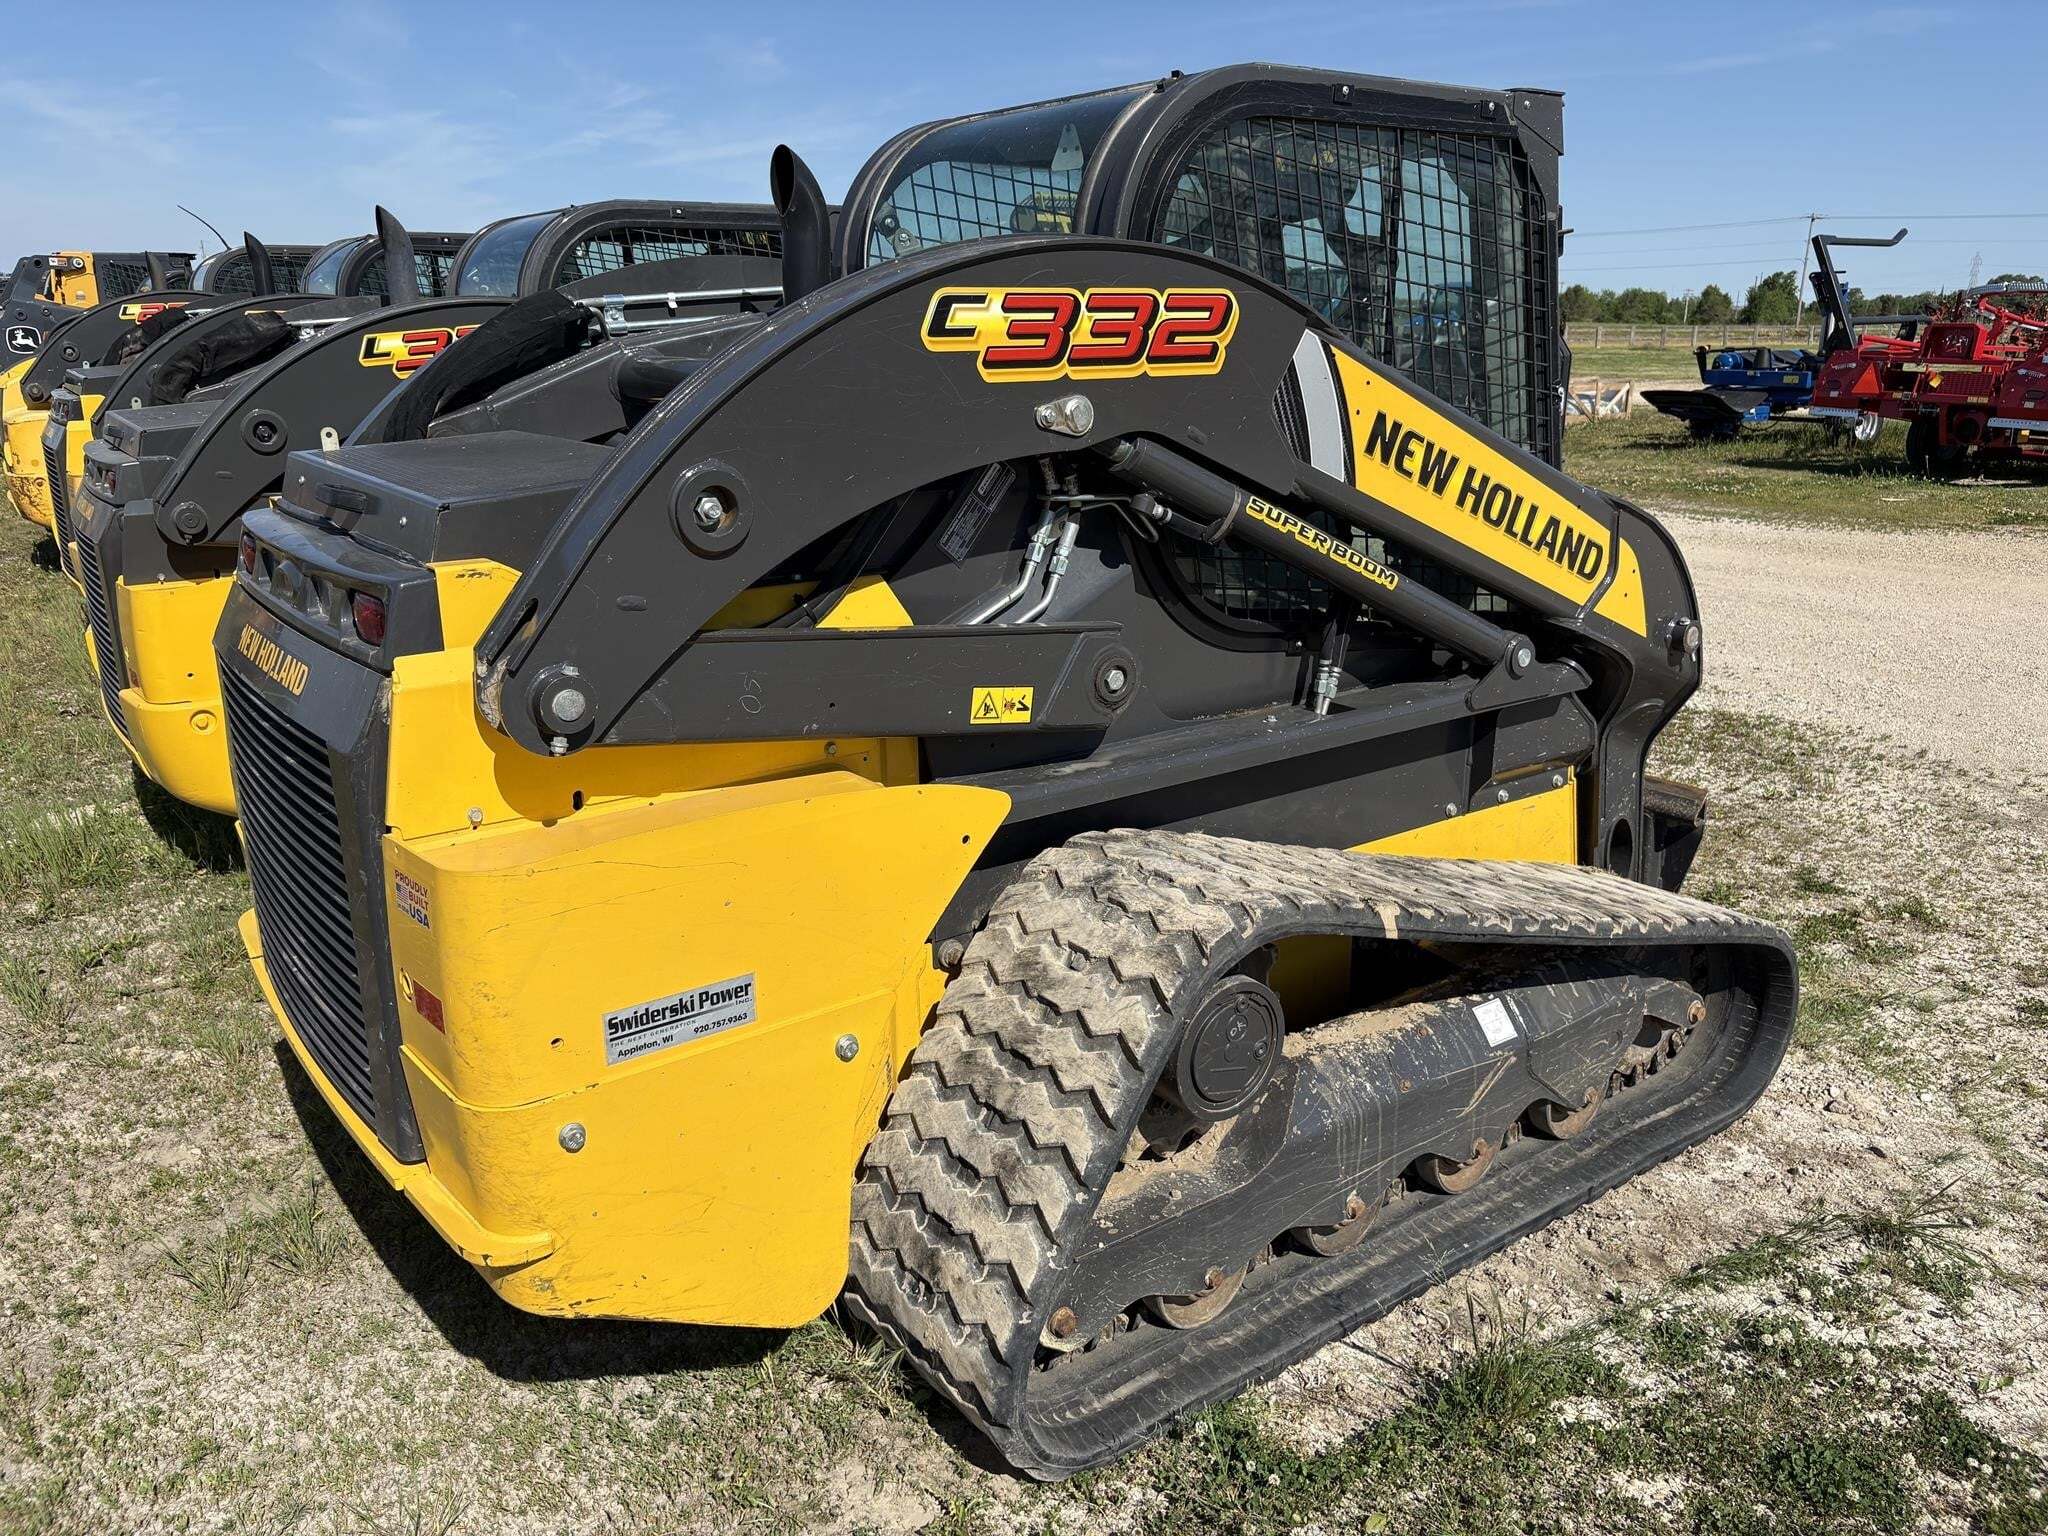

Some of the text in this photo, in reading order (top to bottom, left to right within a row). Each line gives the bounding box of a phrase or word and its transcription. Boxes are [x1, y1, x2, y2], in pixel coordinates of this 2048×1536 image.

[361, 325, 480, 373] L3
[925, 290, 1236, 372] C332
[1363, 410, 1604, 583] NEW HOLLAND
[1247, 497, 1398, 590] SUPER BOOM
[237, 623, 309, 697] NEW HOLLAND
[394, 868, 428, 899] PROUDLY
[408, 889, 429, 911] BUILT
[409, 903, 430, 929] USA
[608, 982, 752, 1036] Swiderski Power
[693, 1012, 748, 1034] 920.757.9363
[617, 1034, 674, 1058] Appleton, WI
